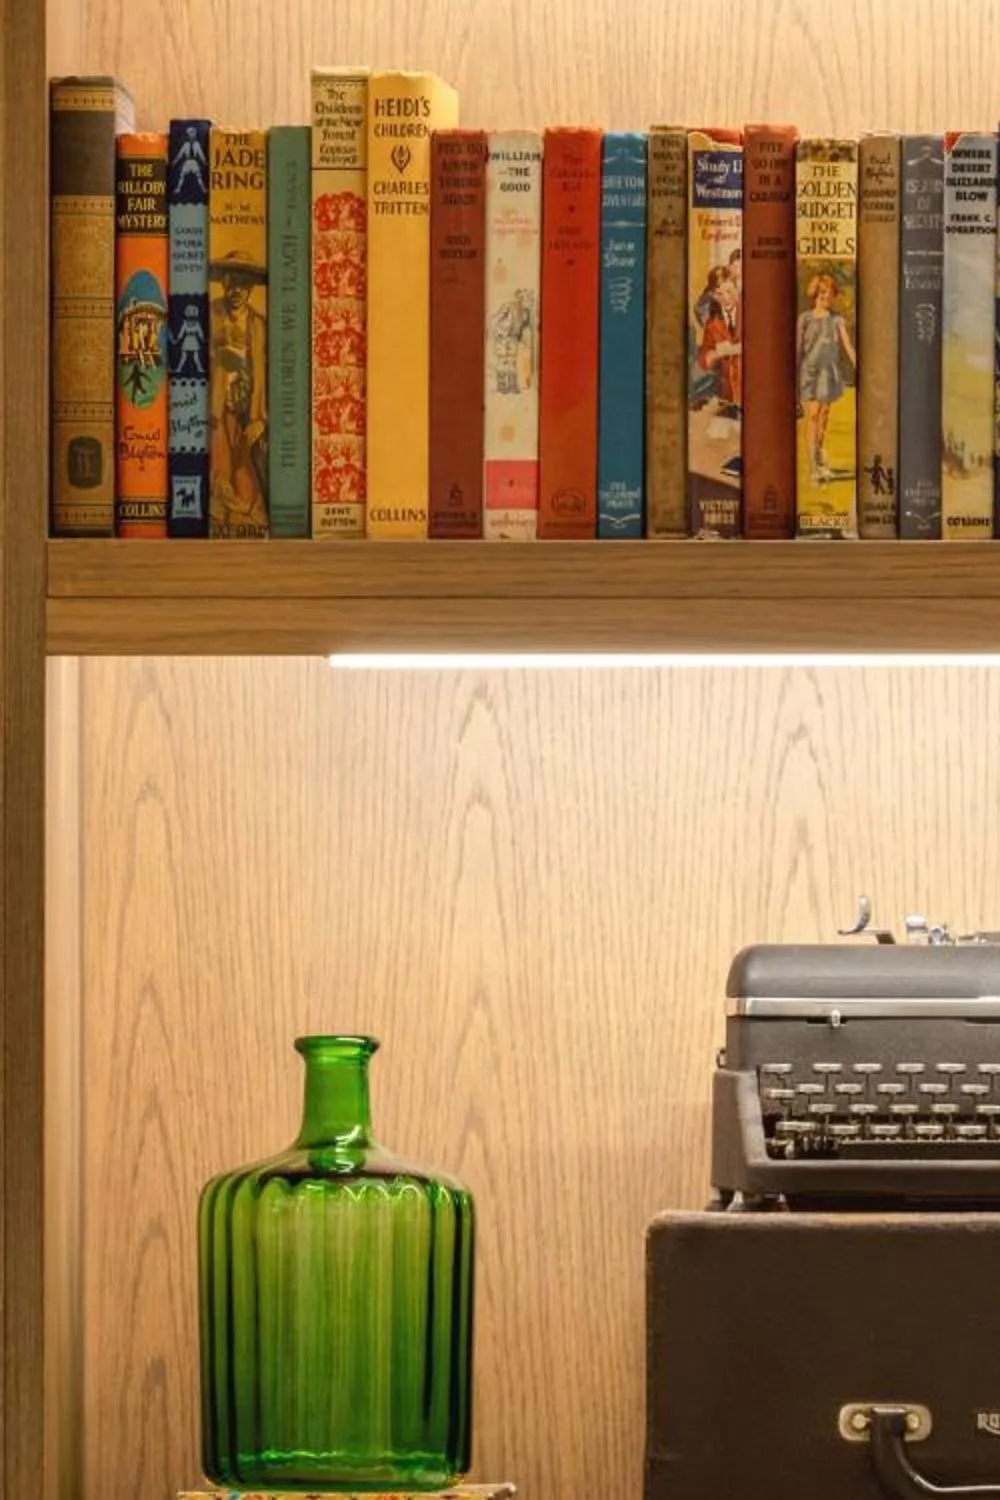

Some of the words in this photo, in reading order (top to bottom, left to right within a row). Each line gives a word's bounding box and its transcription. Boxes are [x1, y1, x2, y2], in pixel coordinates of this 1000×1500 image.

[374, 97, 431, 117] HEIDI'S
[373, 123, 431, 137] CHILDREN
[224, 134, 249, 146] THE
[214, 149, 265, 169] JADE
[491, 151, 541, 161] WILLIAM
[952, 150, 991, 159] WHERE
[130, 164, 153, 177] THE
[697, 159, 731, 175] Study
[812, 165, 841, 177] THE
[952, 164, 991, 173] DESERT
[211, 172, 263, 190] RING
[373, 181, 429, 195] CHARLES
[499, 182, 531, 193] GOOD
[797, 181, 857, 198] GOLDEN
[955, 192, 988, 201] BLOW
[128, 198, 157, 211] FAIR
[373, 201, 429, 215] TRITTEN
[797, 202, 856, 219] BUDGET
[118, 215, 167, 228] MYSTERY
[811, 222, 839, 233] FOR
[797, 237, 855, 255] GIRLS
[280, 234, 297, 293] TEACH
[603, 253, 635, 268] Shaw
[280, 303, 297, 331] WE
[280, 340, 297, 429] CHILDREN
[119, 503, 166, 517] COLLINS
[369, 507, 427, 522] COLLINS
